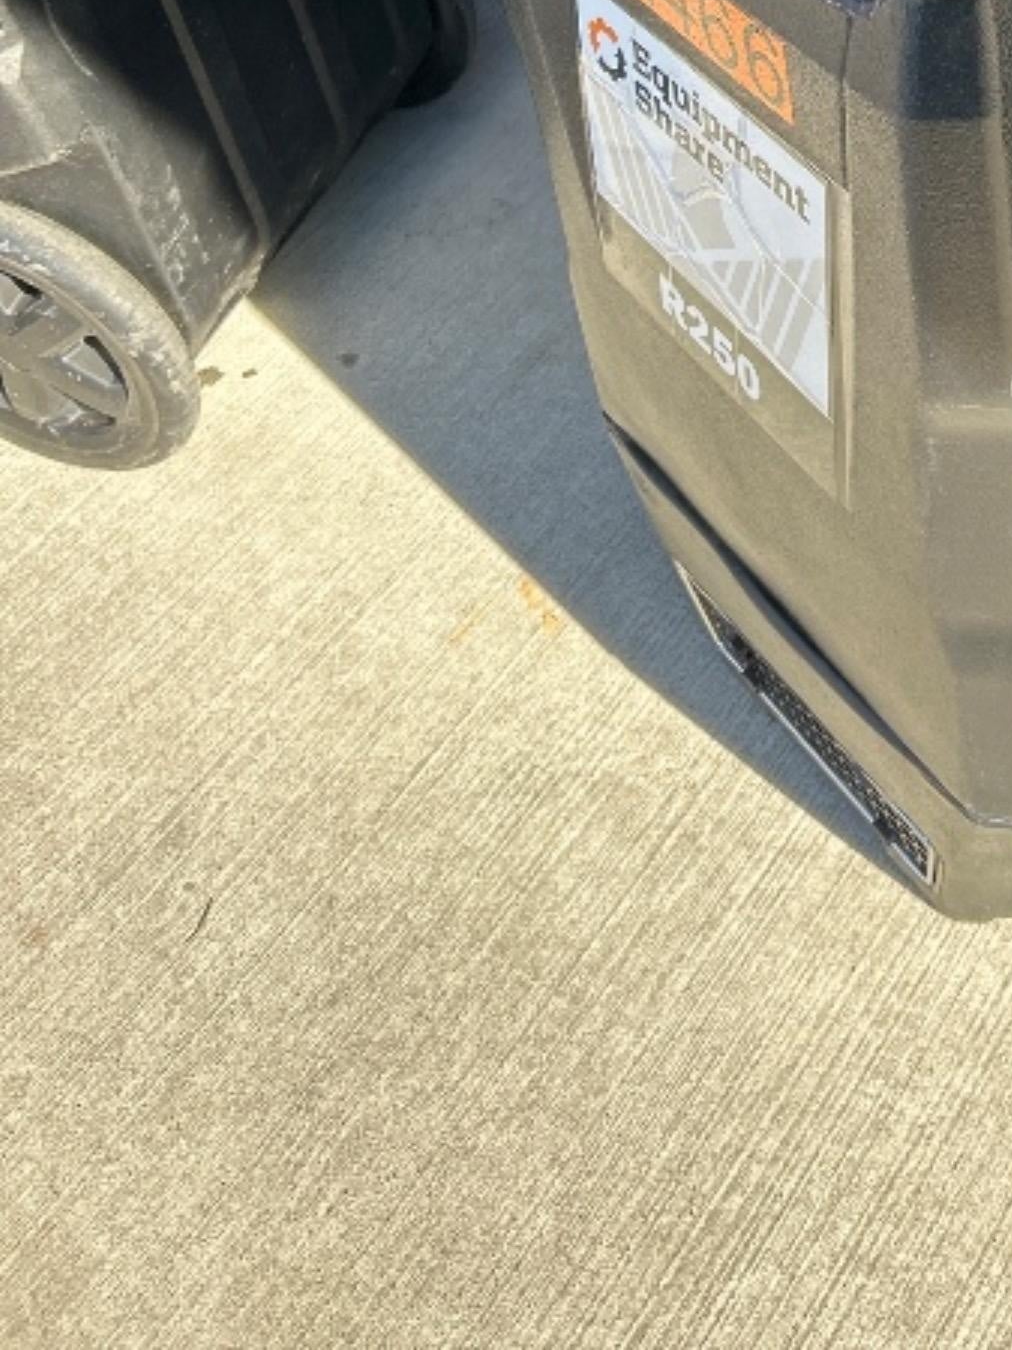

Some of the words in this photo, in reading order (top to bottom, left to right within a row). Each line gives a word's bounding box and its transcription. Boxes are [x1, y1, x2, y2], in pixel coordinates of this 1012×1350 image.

[630, 35, 812, 224] Equipment
[633, 79, 728, 186] Share
[658, 272, 763, 402] R250
